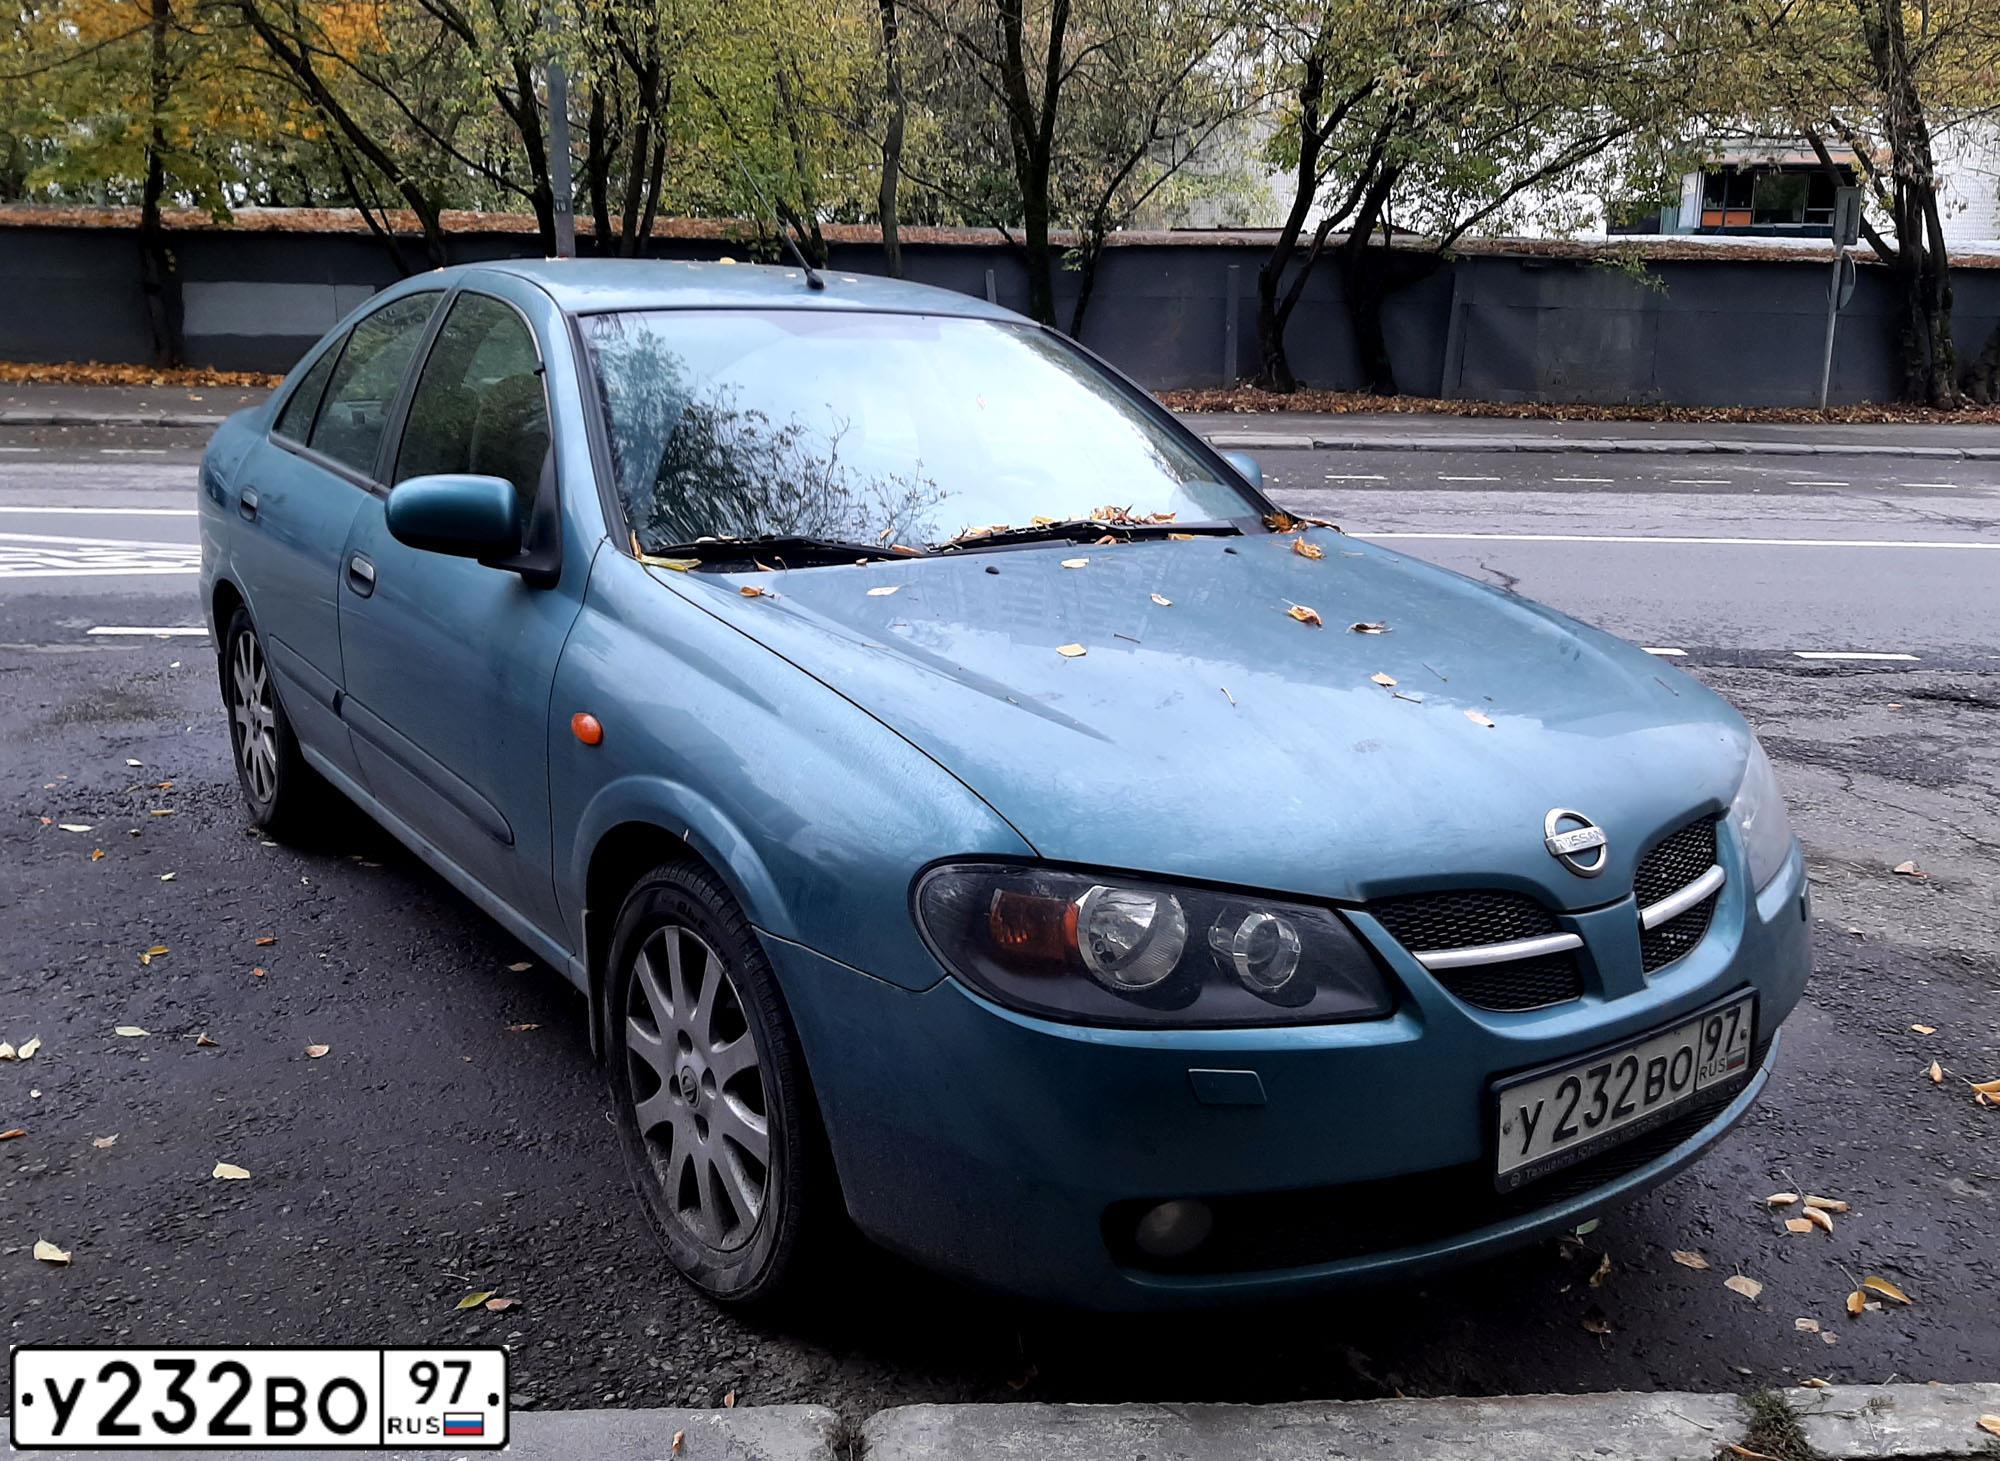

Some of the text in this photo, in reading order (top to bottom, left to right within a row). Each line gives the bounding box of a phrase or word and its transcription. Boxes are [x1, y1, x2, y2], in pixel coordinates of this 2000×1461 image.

[1556, 829, 1601, 850] NISSAN
[1519, 1045, 1693, 1155] У232ВО
[1705, 1006, 1741, 1062] 97
[1699, 1057, 1726, 1082] RUS
